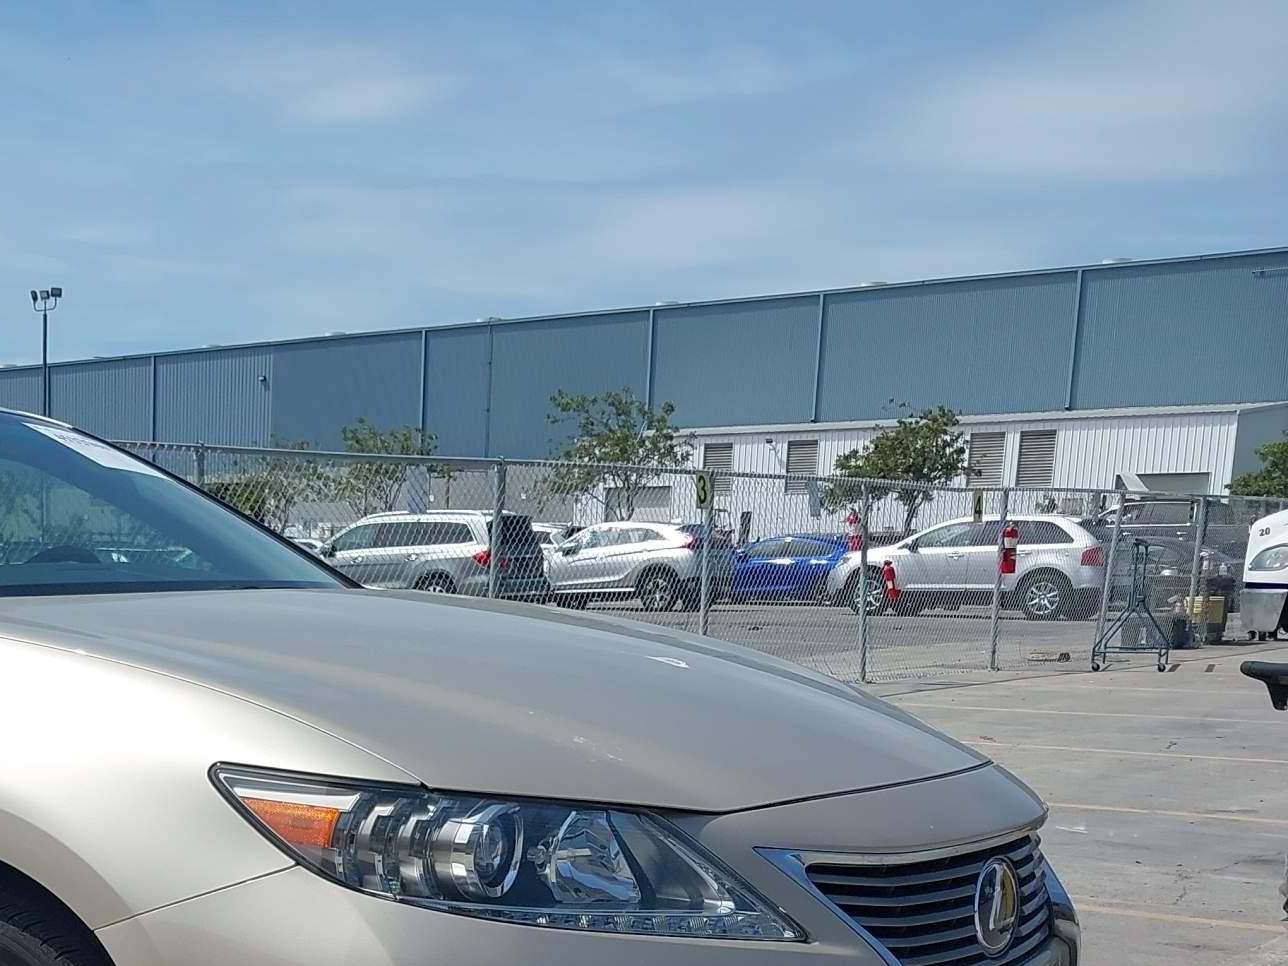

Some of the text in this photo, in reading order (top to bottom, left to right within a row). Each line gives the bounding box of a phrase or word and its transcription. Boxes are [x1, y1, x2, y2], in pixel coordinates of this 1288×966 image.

[698, 475, 707, 504] 3
[974, 495, 982, 519] 4
[1258, 527, 1271, 537] 20
